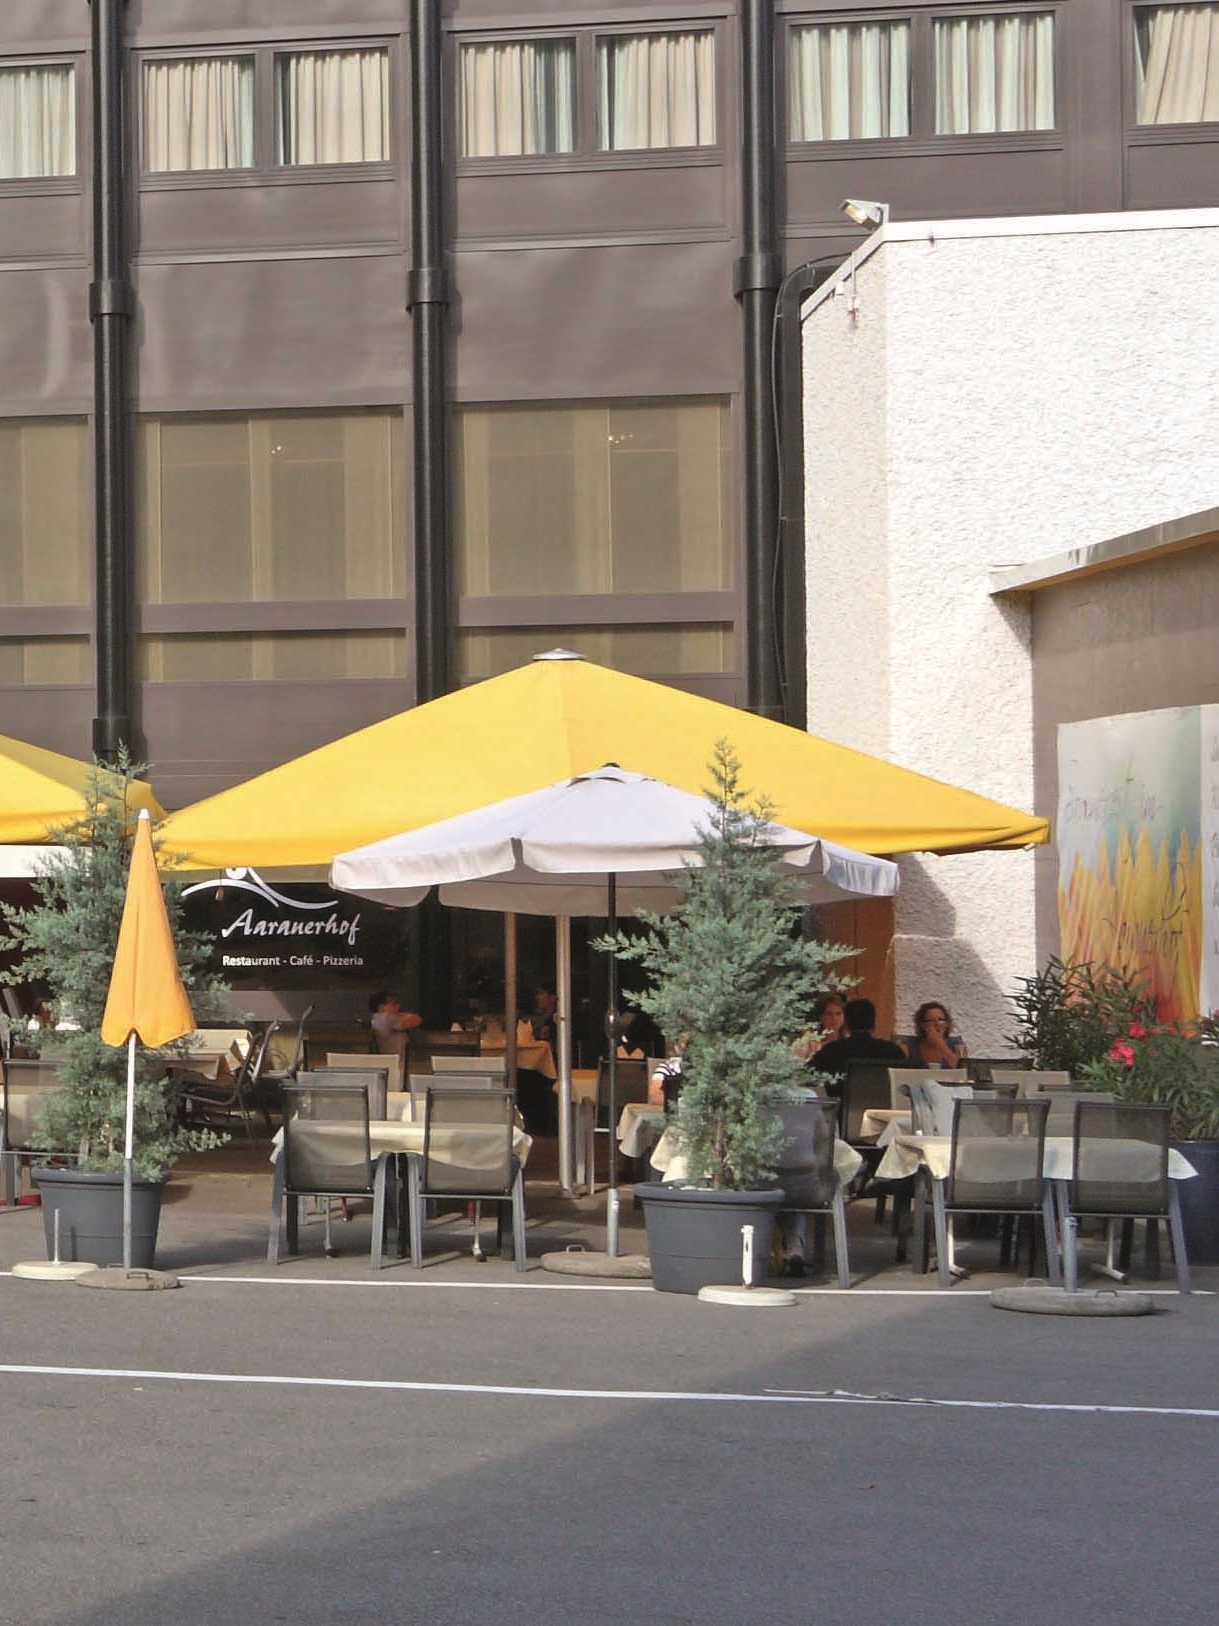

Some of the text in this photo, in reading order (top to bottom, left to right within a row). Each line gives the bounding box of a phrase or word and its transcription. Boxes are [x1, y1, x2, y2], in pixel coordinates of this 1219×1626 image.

[221, 908, 360, 945] Aarauerhof
[222, 955, 280, 966] Restaurant
[289, 955, 314, 966] Café
[323, 955, 364, 966] Pizzeria
